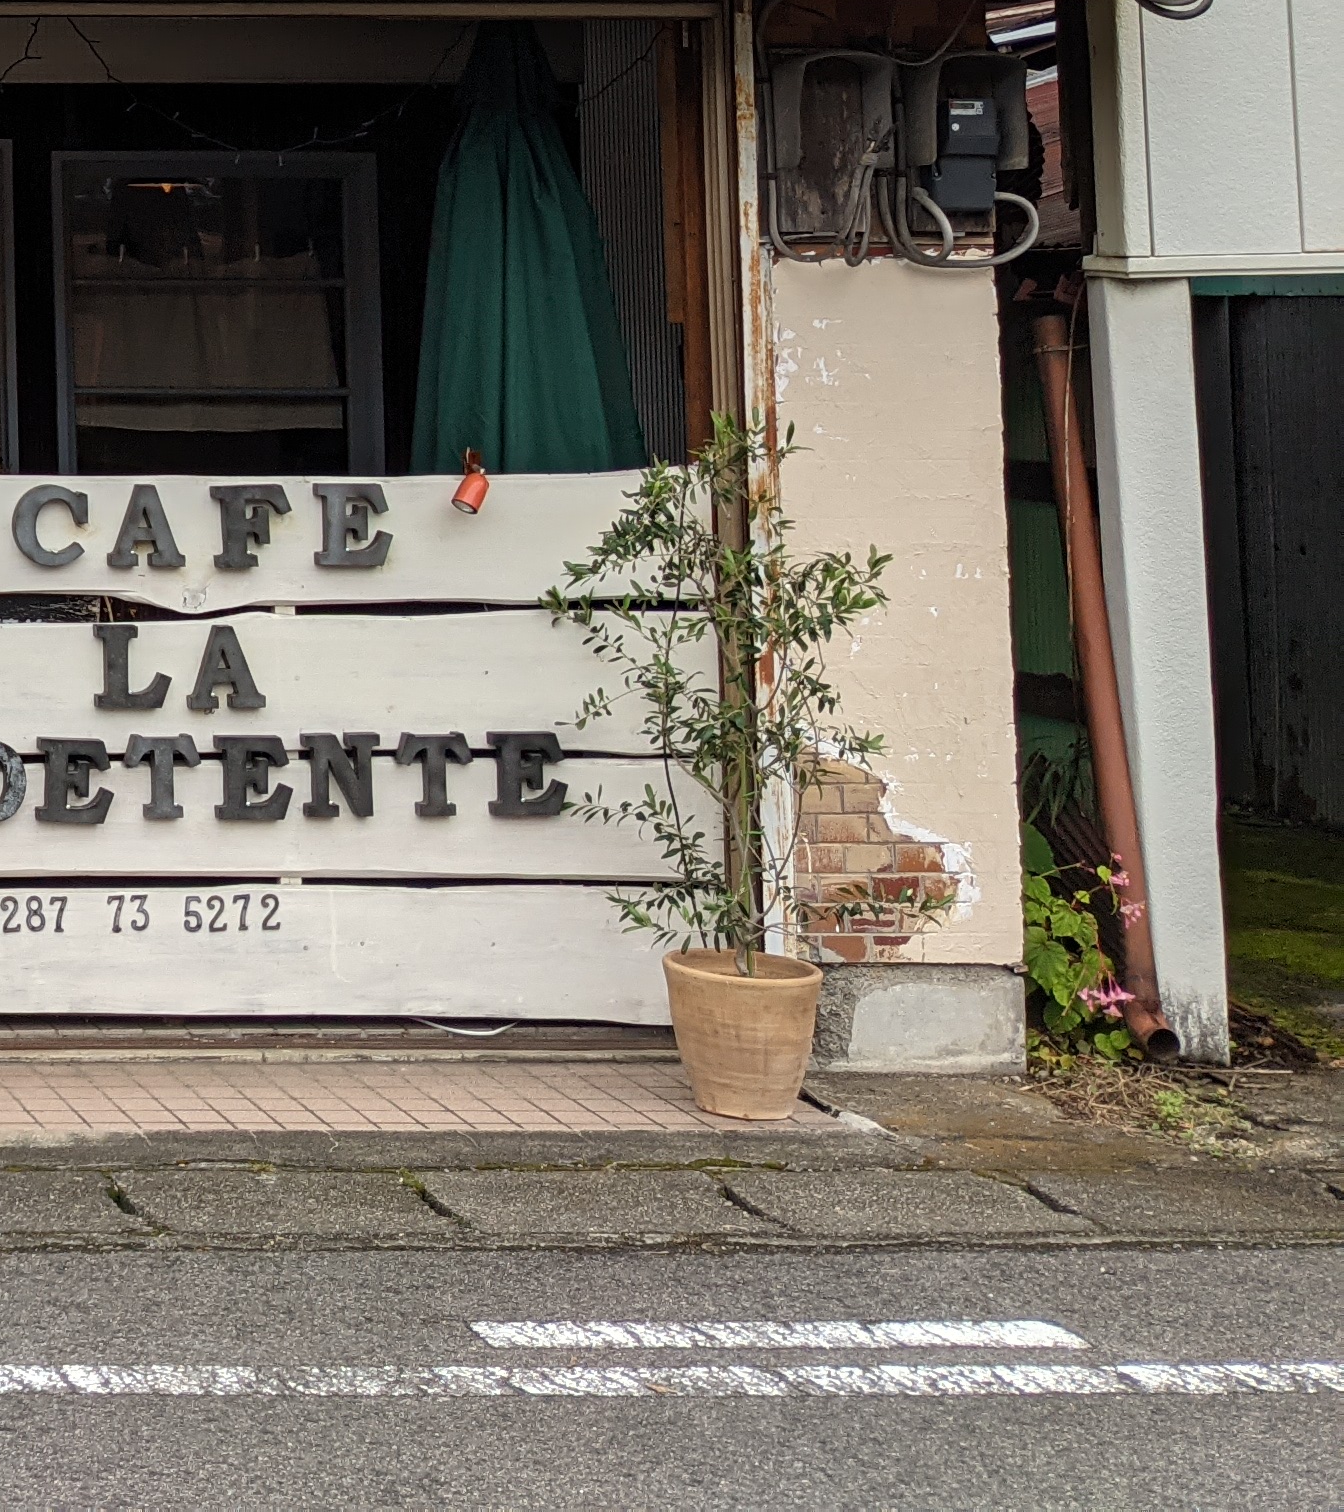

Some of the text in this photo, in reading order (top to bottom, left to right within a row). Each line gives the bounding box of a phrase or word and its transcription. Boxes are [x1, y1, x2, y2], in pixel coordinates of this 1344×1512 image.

[11, 484, 394, 570] CAFE
[93, 624, 266, 710] LA
[106, 895, 151, 933] 73
[182, 893, 283, 932] 5272
